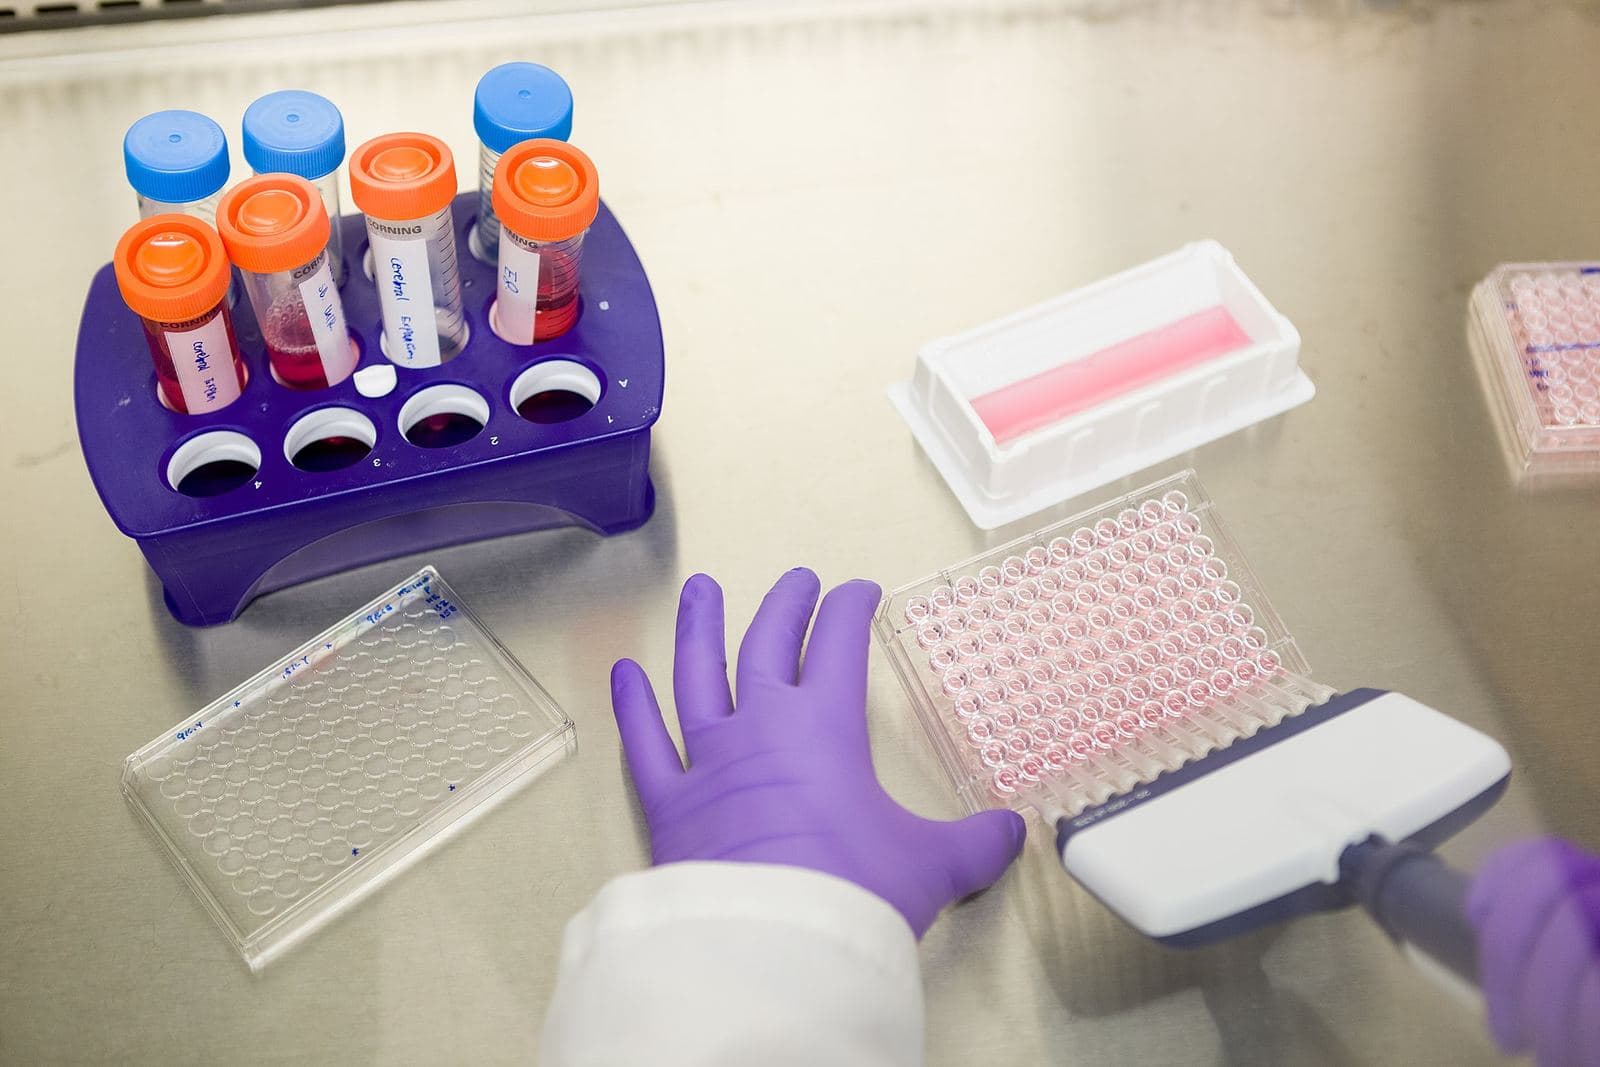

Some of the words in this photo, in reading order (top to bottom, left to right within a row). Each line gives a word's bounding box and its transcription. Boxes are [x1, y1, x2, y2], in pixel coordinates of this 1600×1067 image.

[367, 216, 422, 235] CORNING
[293, 249, 325, 279] CORN
[607, 415, 614, 424] 1
[490, 436, 499, 445] 2
[372, 458, 382, 467] 3
[254, 480, 262, 489] 4
